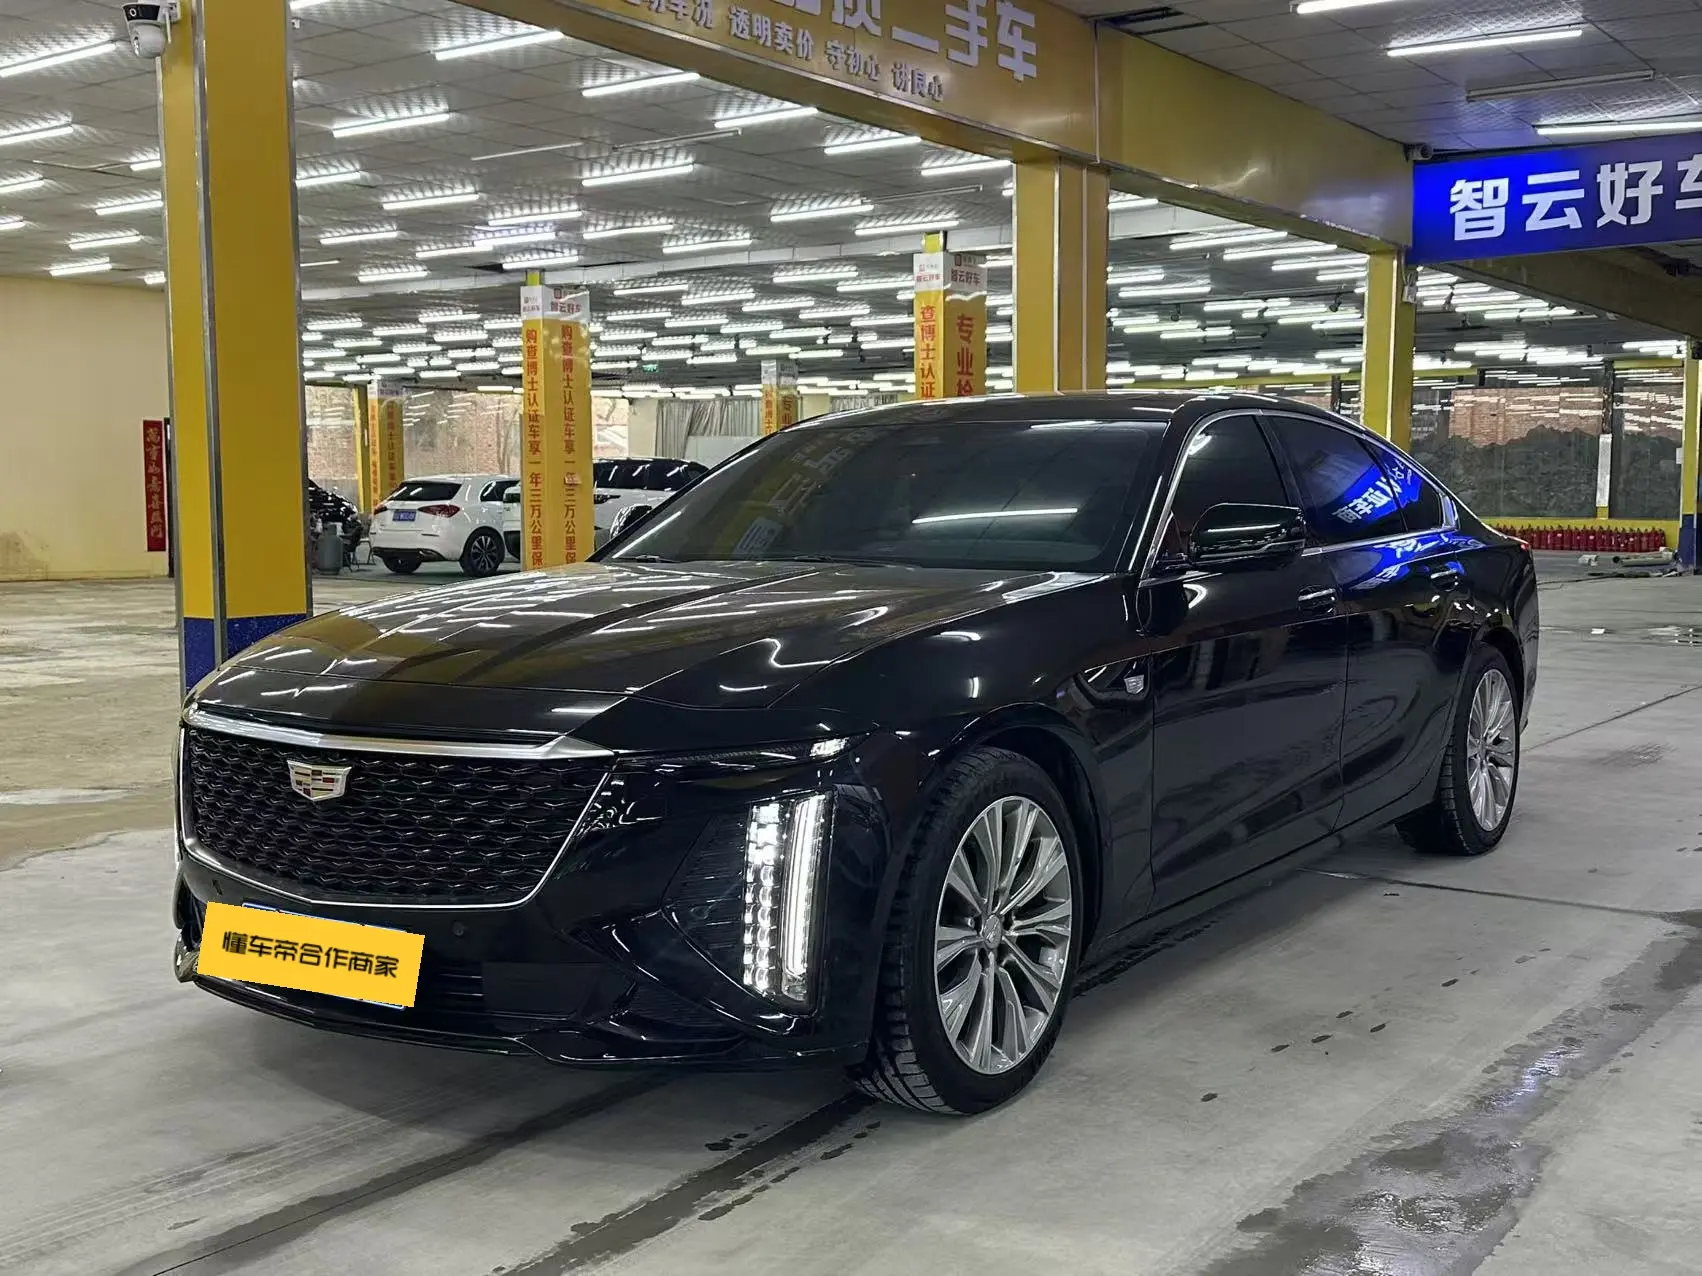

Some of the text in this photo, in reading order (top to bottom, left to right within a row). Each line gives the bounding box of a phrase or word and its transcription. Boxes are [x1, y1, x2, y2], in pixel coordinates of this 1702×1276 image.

[728, 5, 815, 61] 透明卖价
[826, 40, 880, 81] 守初心
